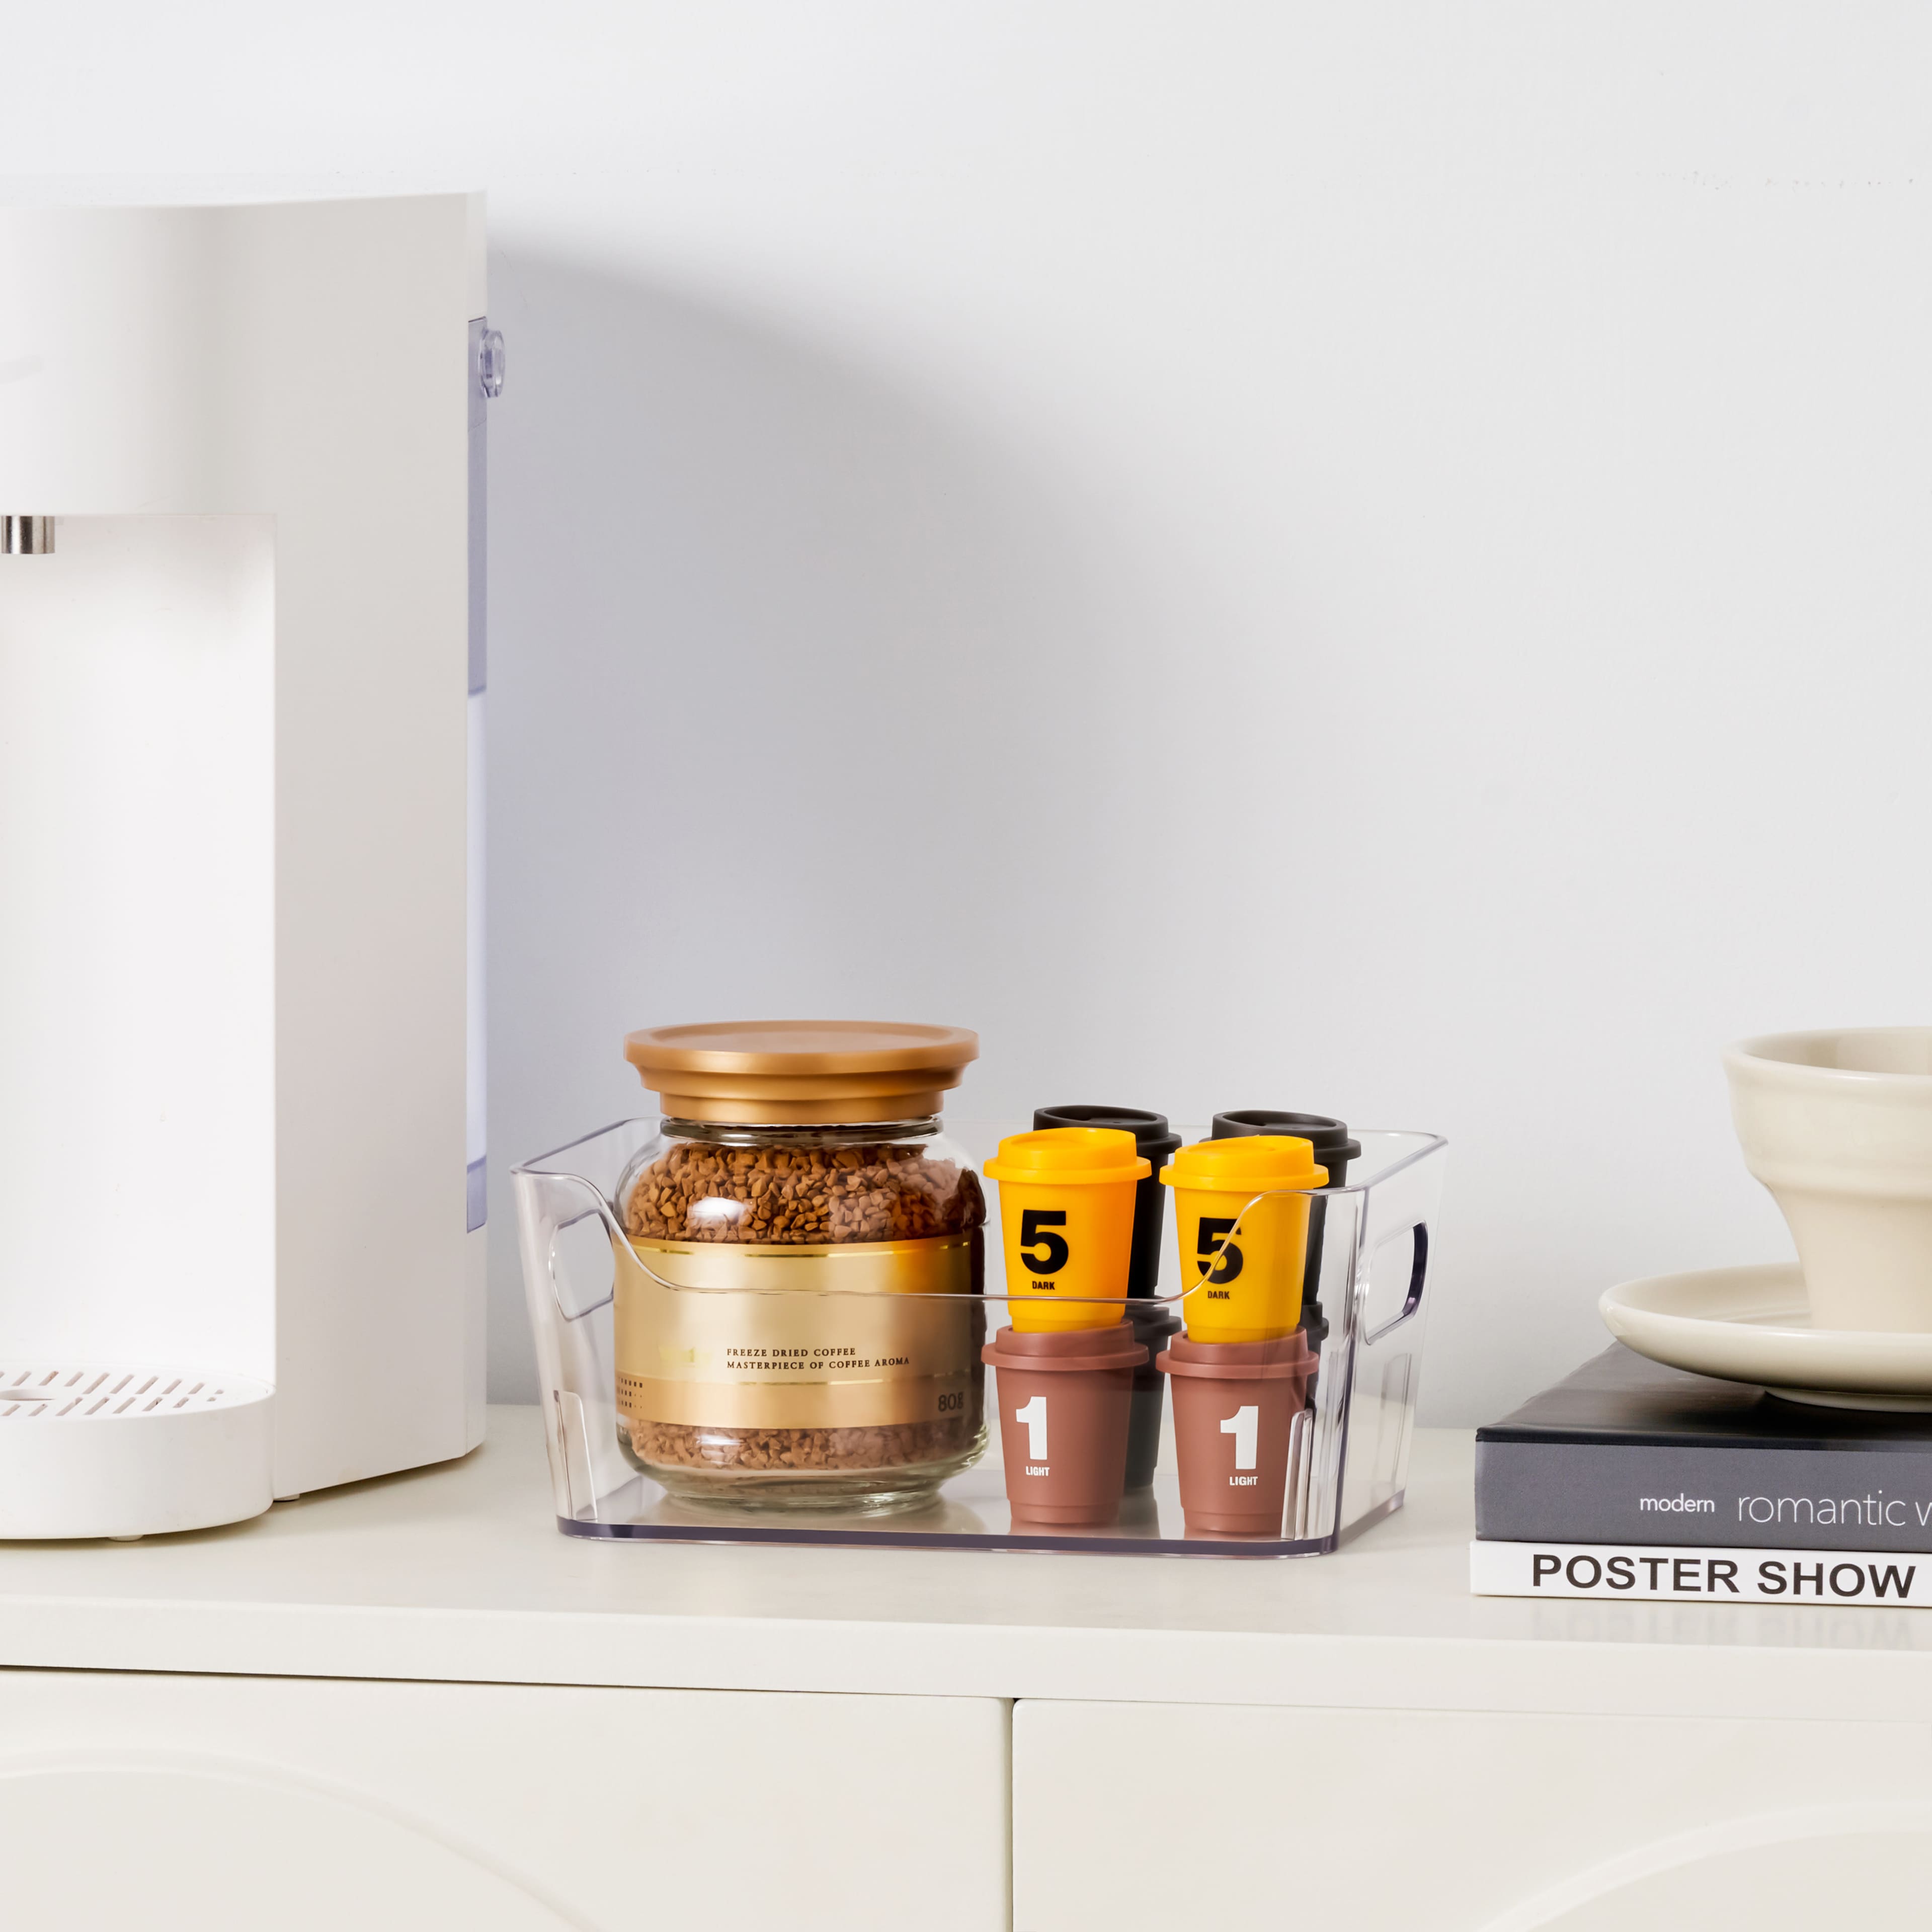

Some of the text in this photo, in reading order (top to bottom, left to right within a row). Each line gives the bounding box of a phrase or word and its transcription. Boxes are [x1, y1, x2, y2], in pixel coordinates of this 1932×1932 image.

[1020, 1209, 1069, 1275] 5
[1197, 1217, 1244, 1284] 5
[1032, 1281, 1056, 1291] DARK
[1208, 1291, 1231, 1300] DARK
[727, 1348, 856, 1357] FREEZE DRIED COFFEE
[727, 1357, 910, 1370] MASTERPIECE OF COFFEE AROMA
[1015, 1396, 1048, 1461] 1
[1220, 1406, 1259, 1470] 1
[1025, 1466, 1051, 1477] LIGHT
[1229, 1476, 1258, 1487] LIGHT
[1640, 1492, 1715, 1513] modern
[1738, 1490, 1906, 1526] romantic
[1533, 1554, 1916, 1598] POSTER SHOW
